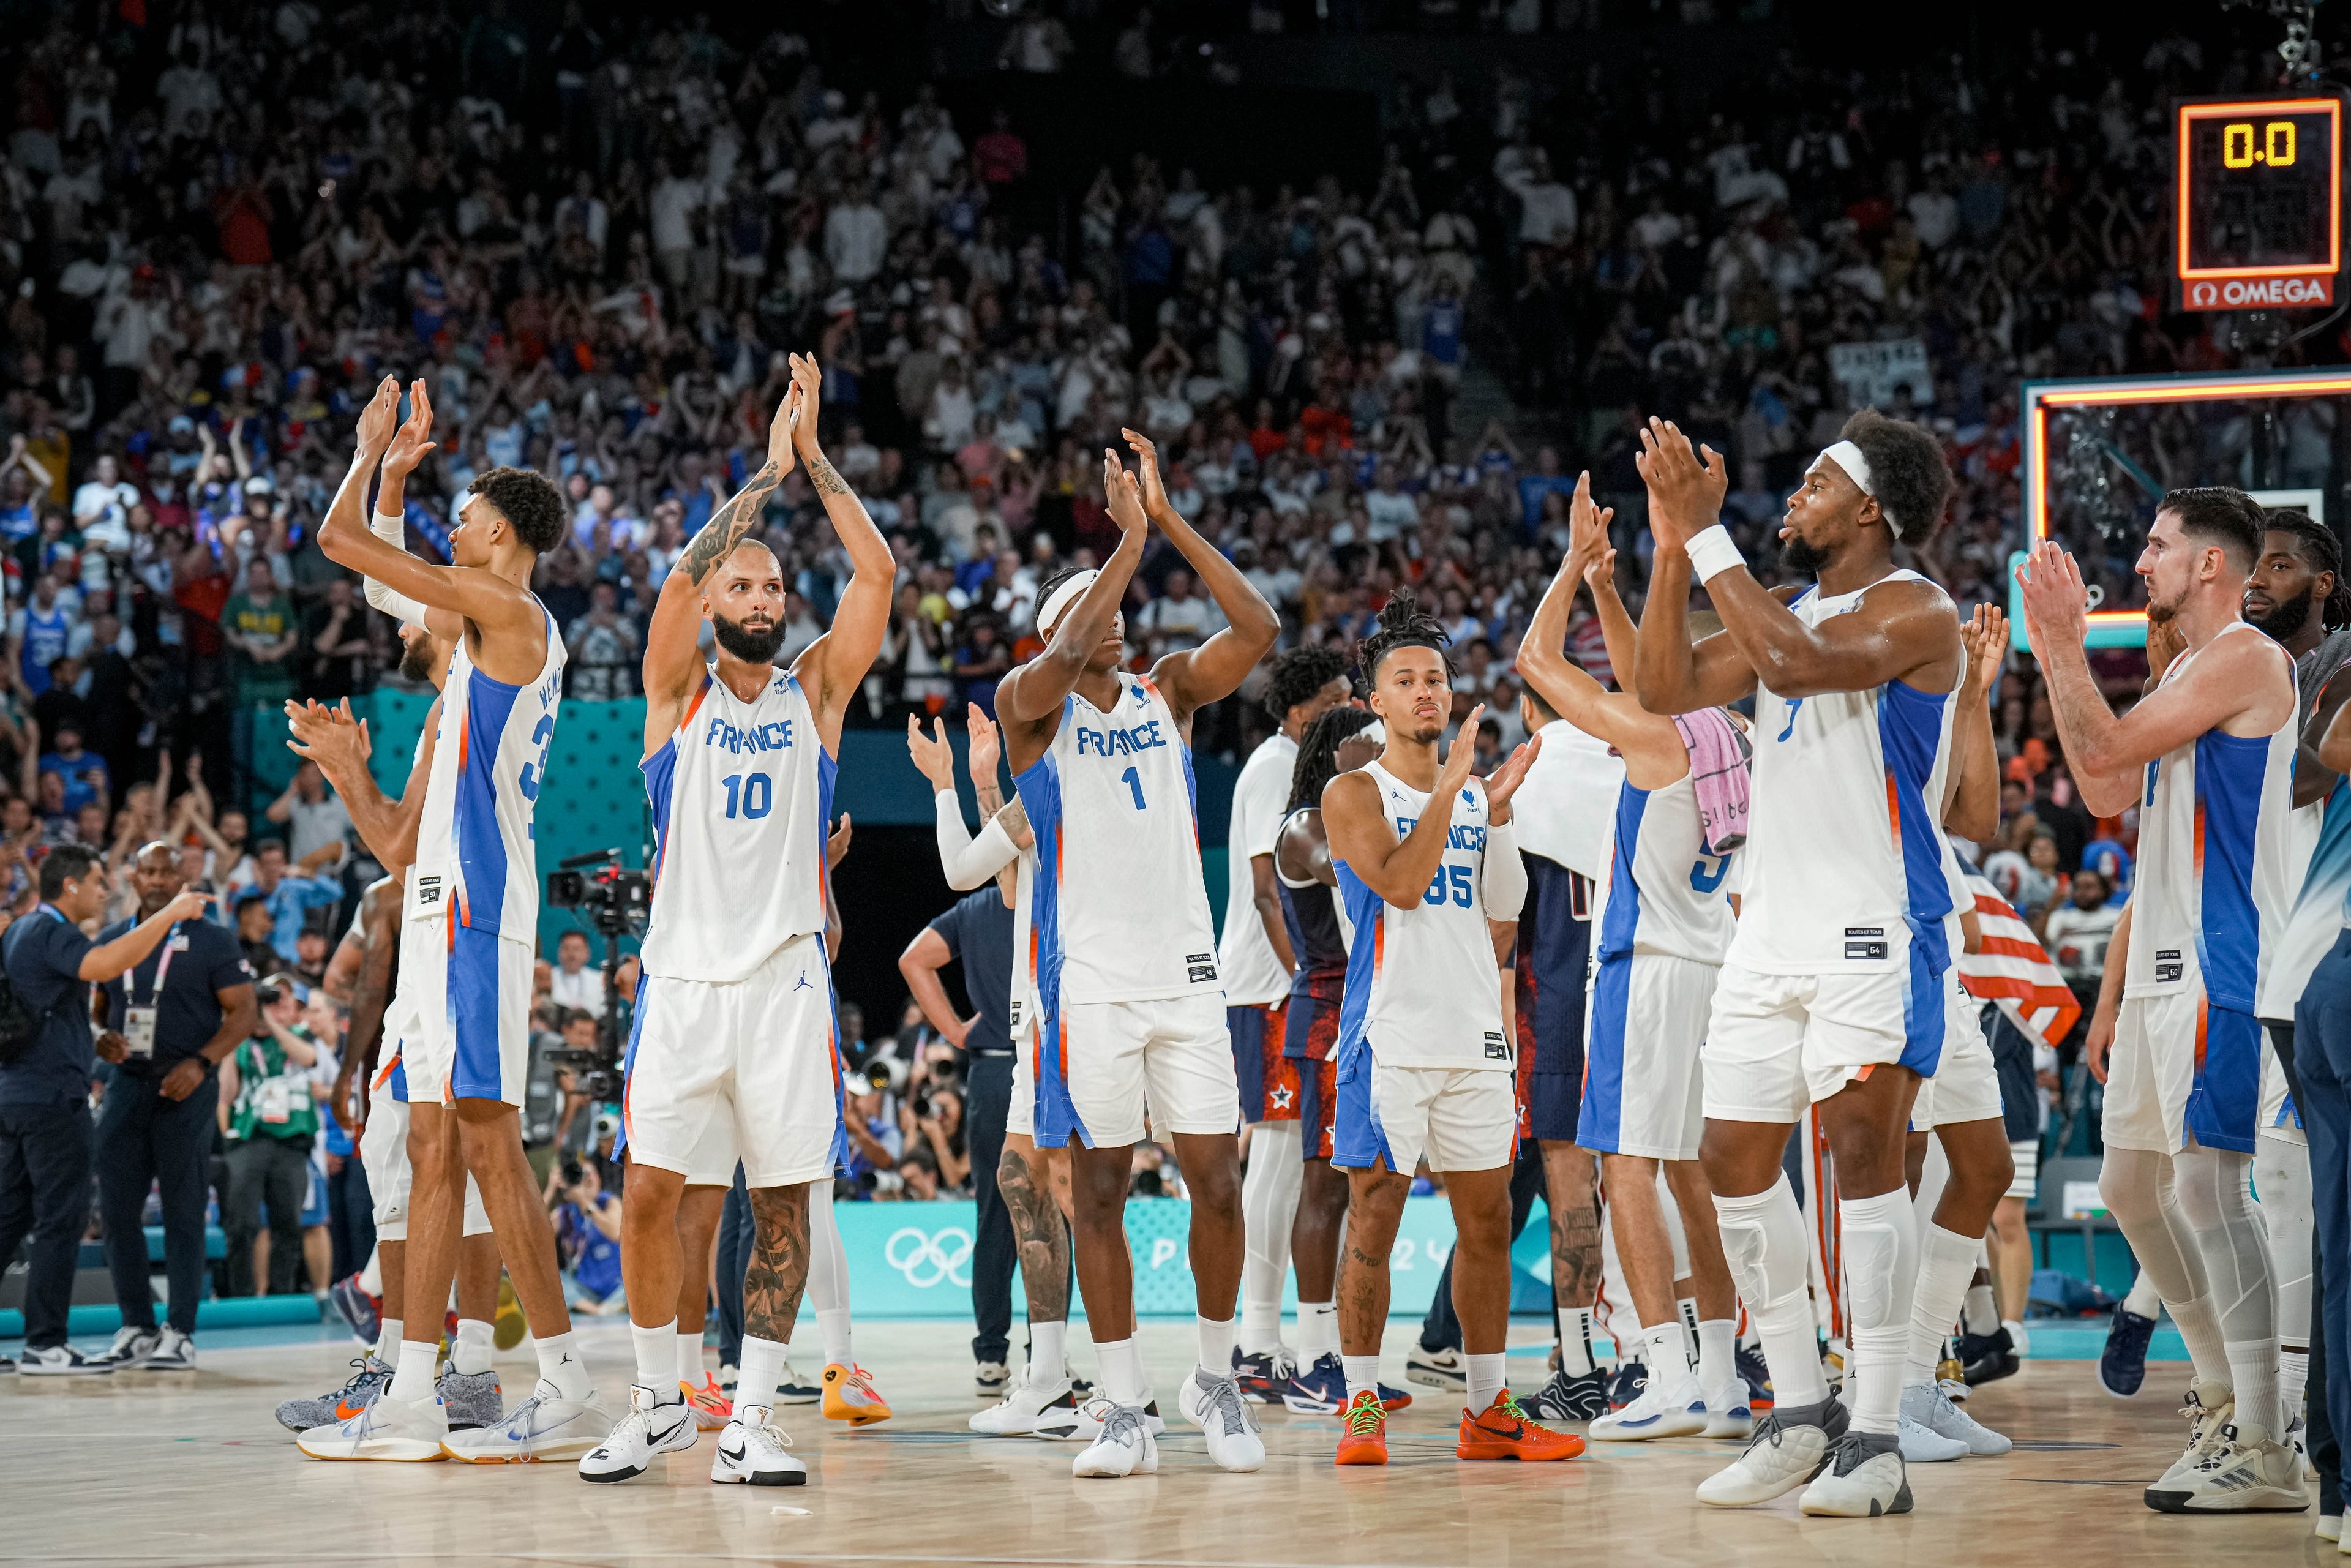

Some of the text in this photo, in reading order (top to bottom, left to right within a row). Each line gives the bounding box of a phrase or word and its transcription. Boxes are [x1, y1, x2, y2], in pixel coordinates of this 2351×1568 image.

[2224, 122, 2295, 168] 0.0
[2224, 279, 2326, 305] OMEGA
[706, 718, 792, 754] FRANCE
[1077, 720, 1166, 757] FRANCE
[722, 773, 771, 819] 10
[1121, 766, 1146, 811] 1
[1397, 817, 1486, 852] FNCE
